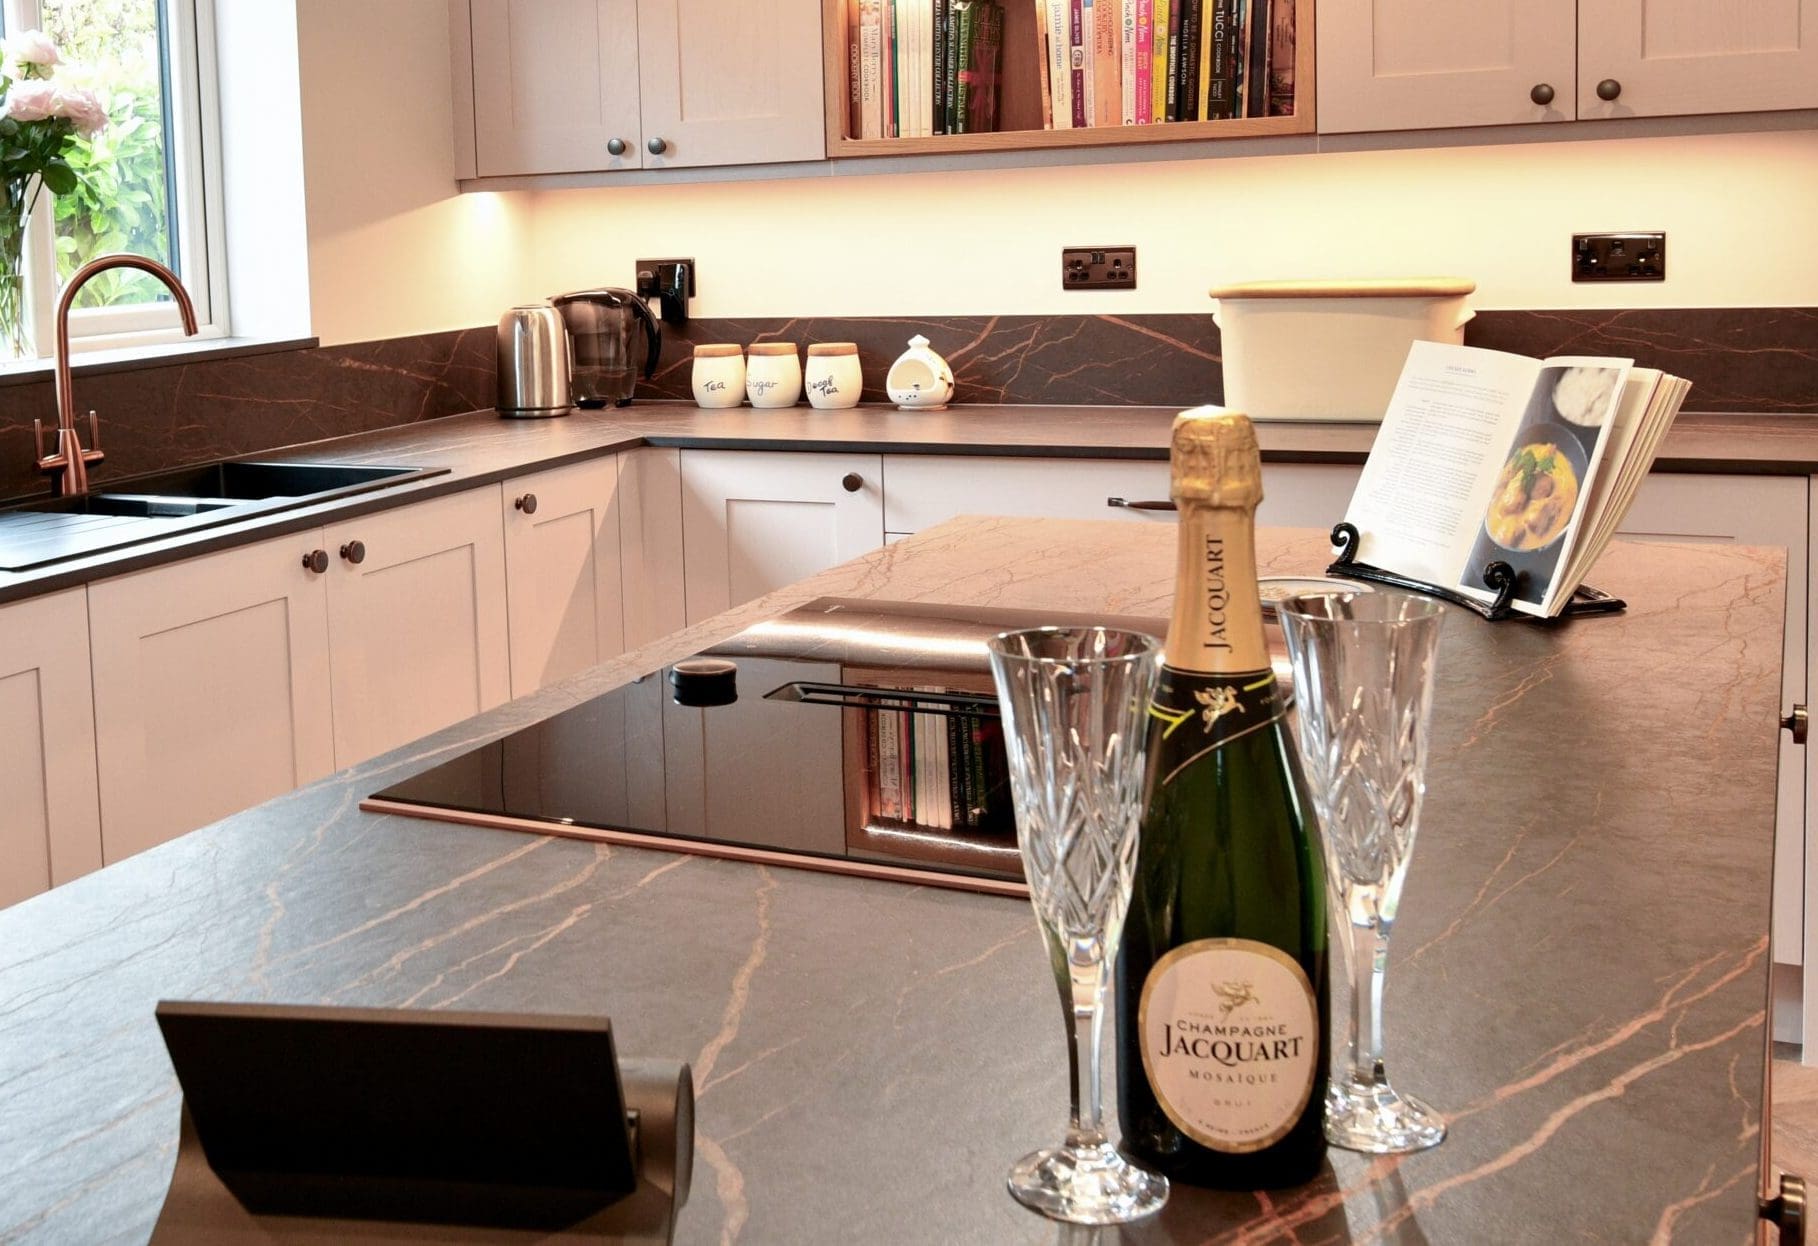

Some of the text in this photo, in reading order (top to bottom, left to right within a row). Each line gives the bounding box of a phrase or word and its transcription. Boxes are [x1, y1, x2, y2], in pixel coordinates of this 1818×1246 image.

[1214, 10, 1225, 42] TUCCI
[704, 381, 726, 393] Tea
[820, 386, 839, 397] Tea
[1203, 533, 1233, 654] JACQUART
[1176, 1019, 1287, 1037] CHAMPAGNE
[1159, 1022, 1304, 1067] JACQUART
